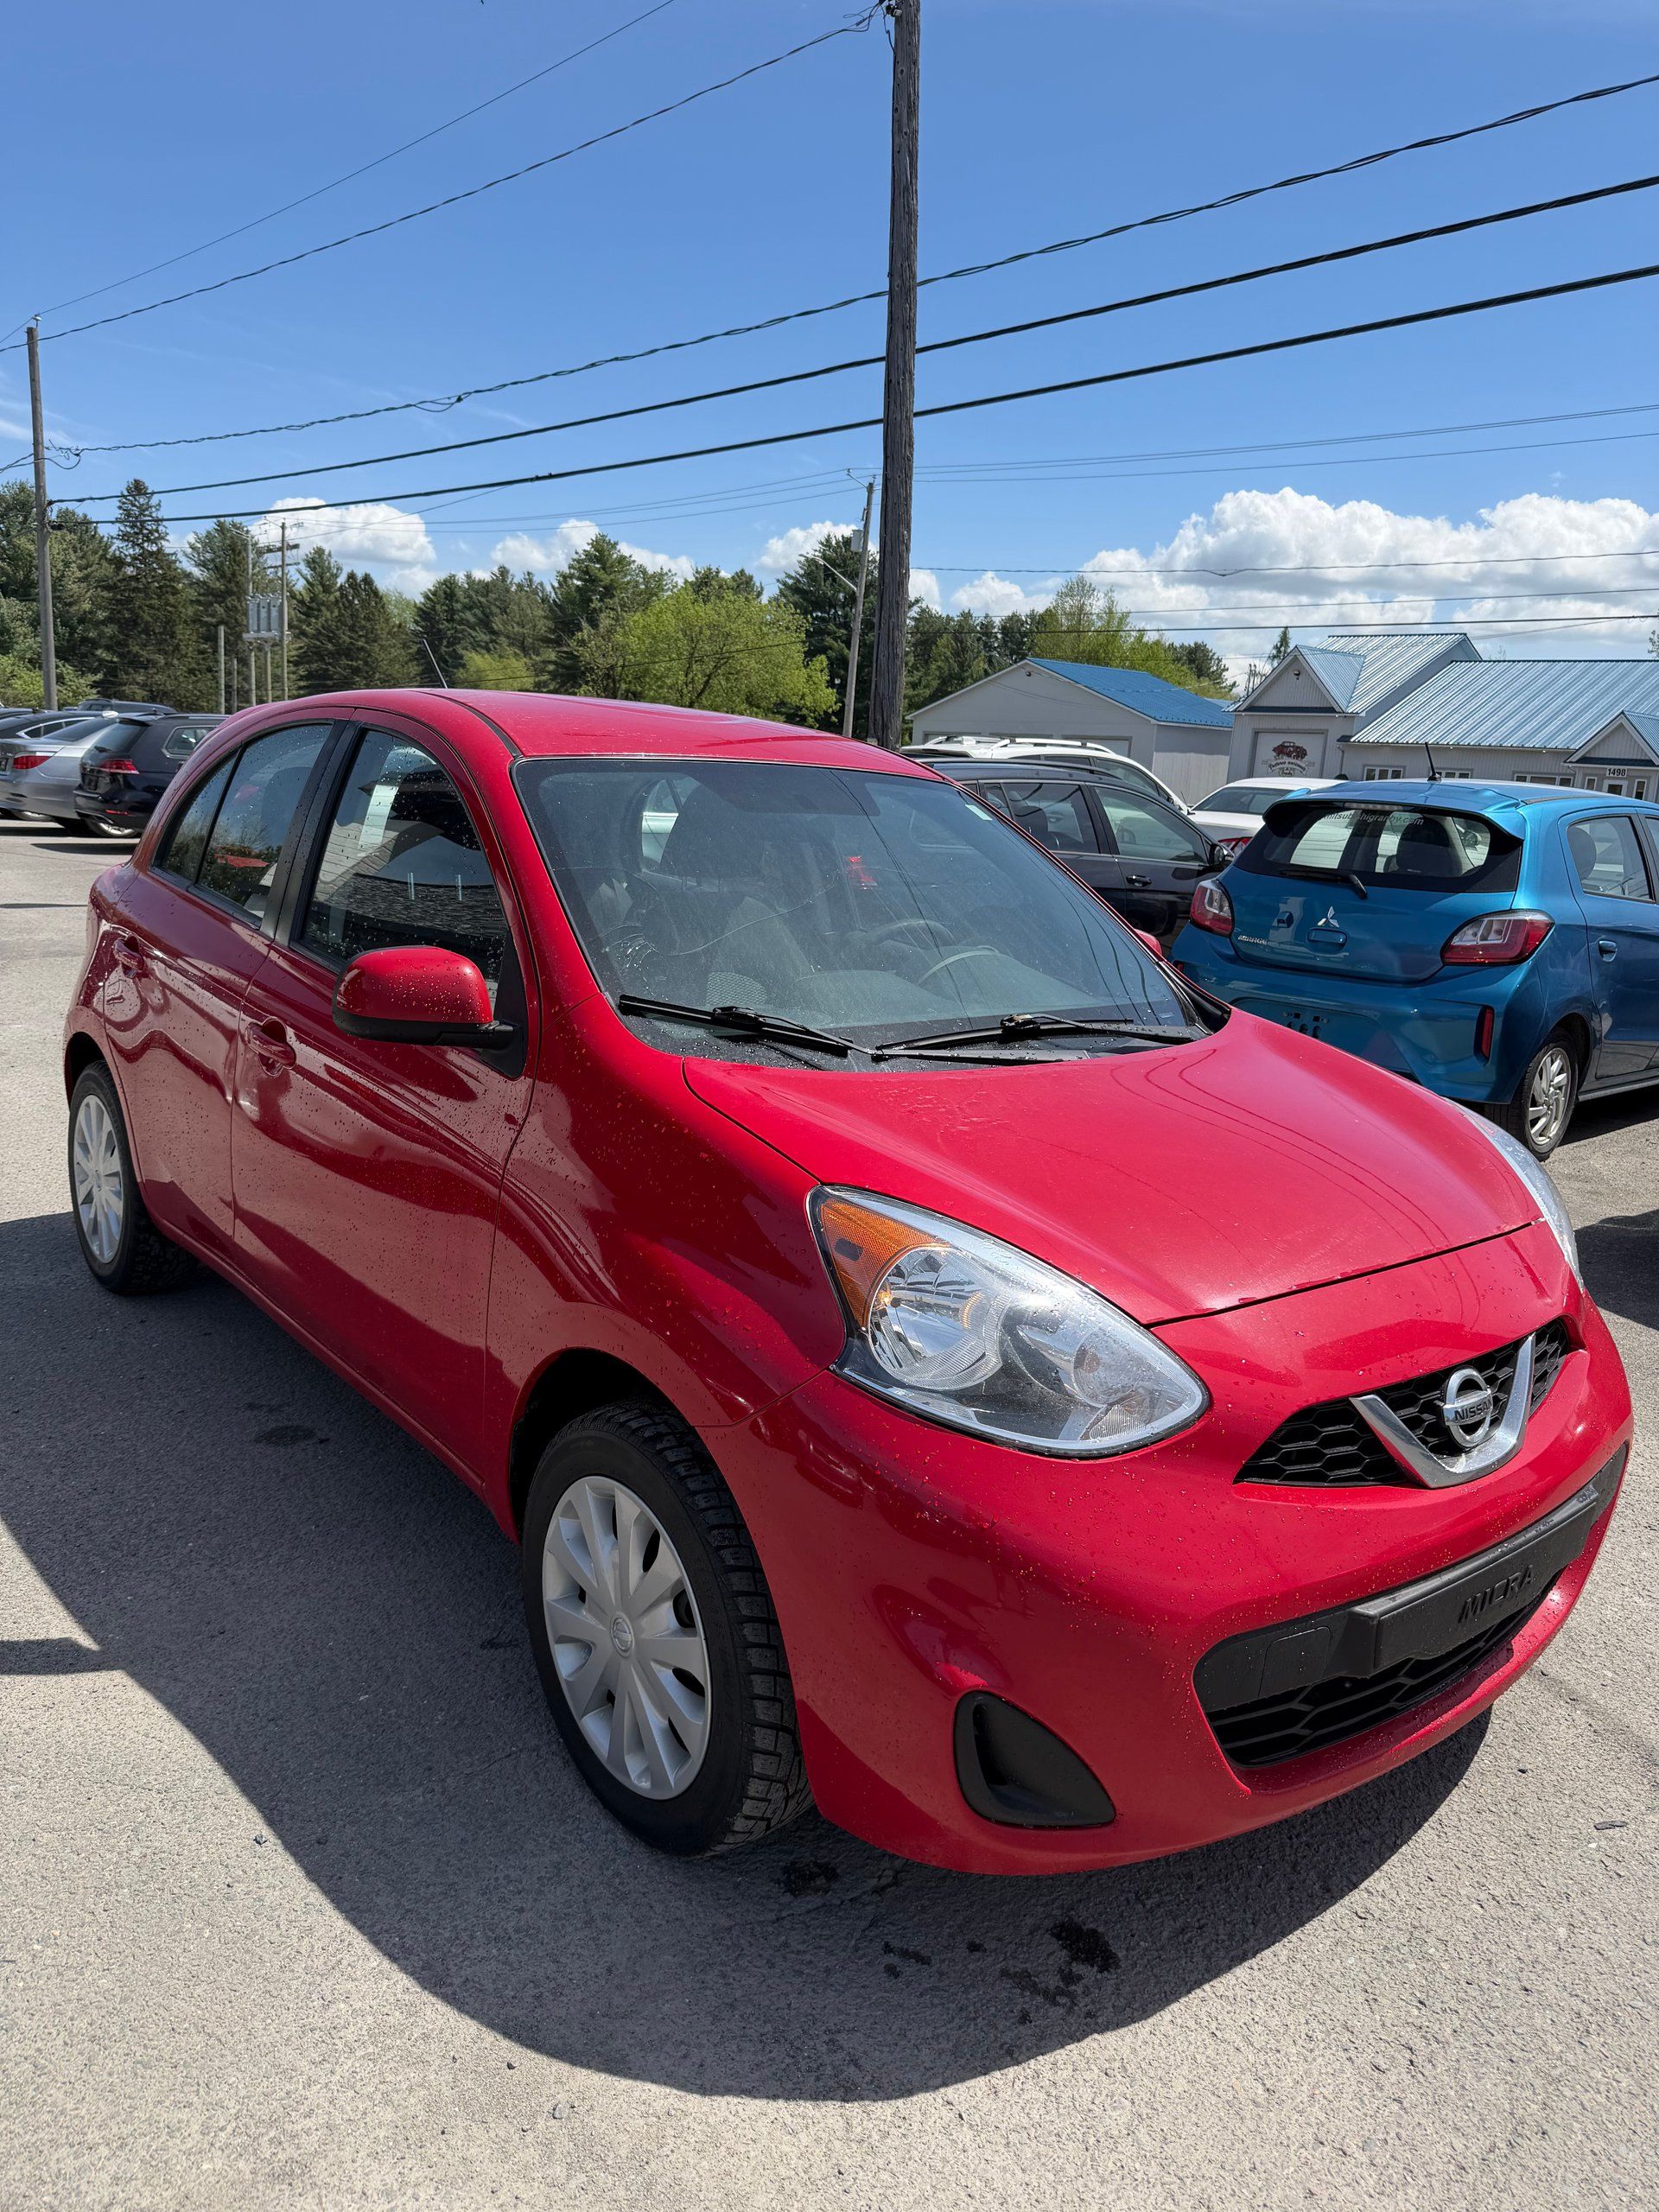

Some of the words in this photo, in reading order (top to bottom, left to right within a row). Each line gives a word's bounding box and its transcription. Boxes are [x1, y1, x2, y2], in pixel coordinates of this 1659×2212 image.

[1608, 768, 1626, 777] 1498
[1454, 1398, 1492, 1421] NISSAN
[1458, 1565, 1534, 1624] MICRA
